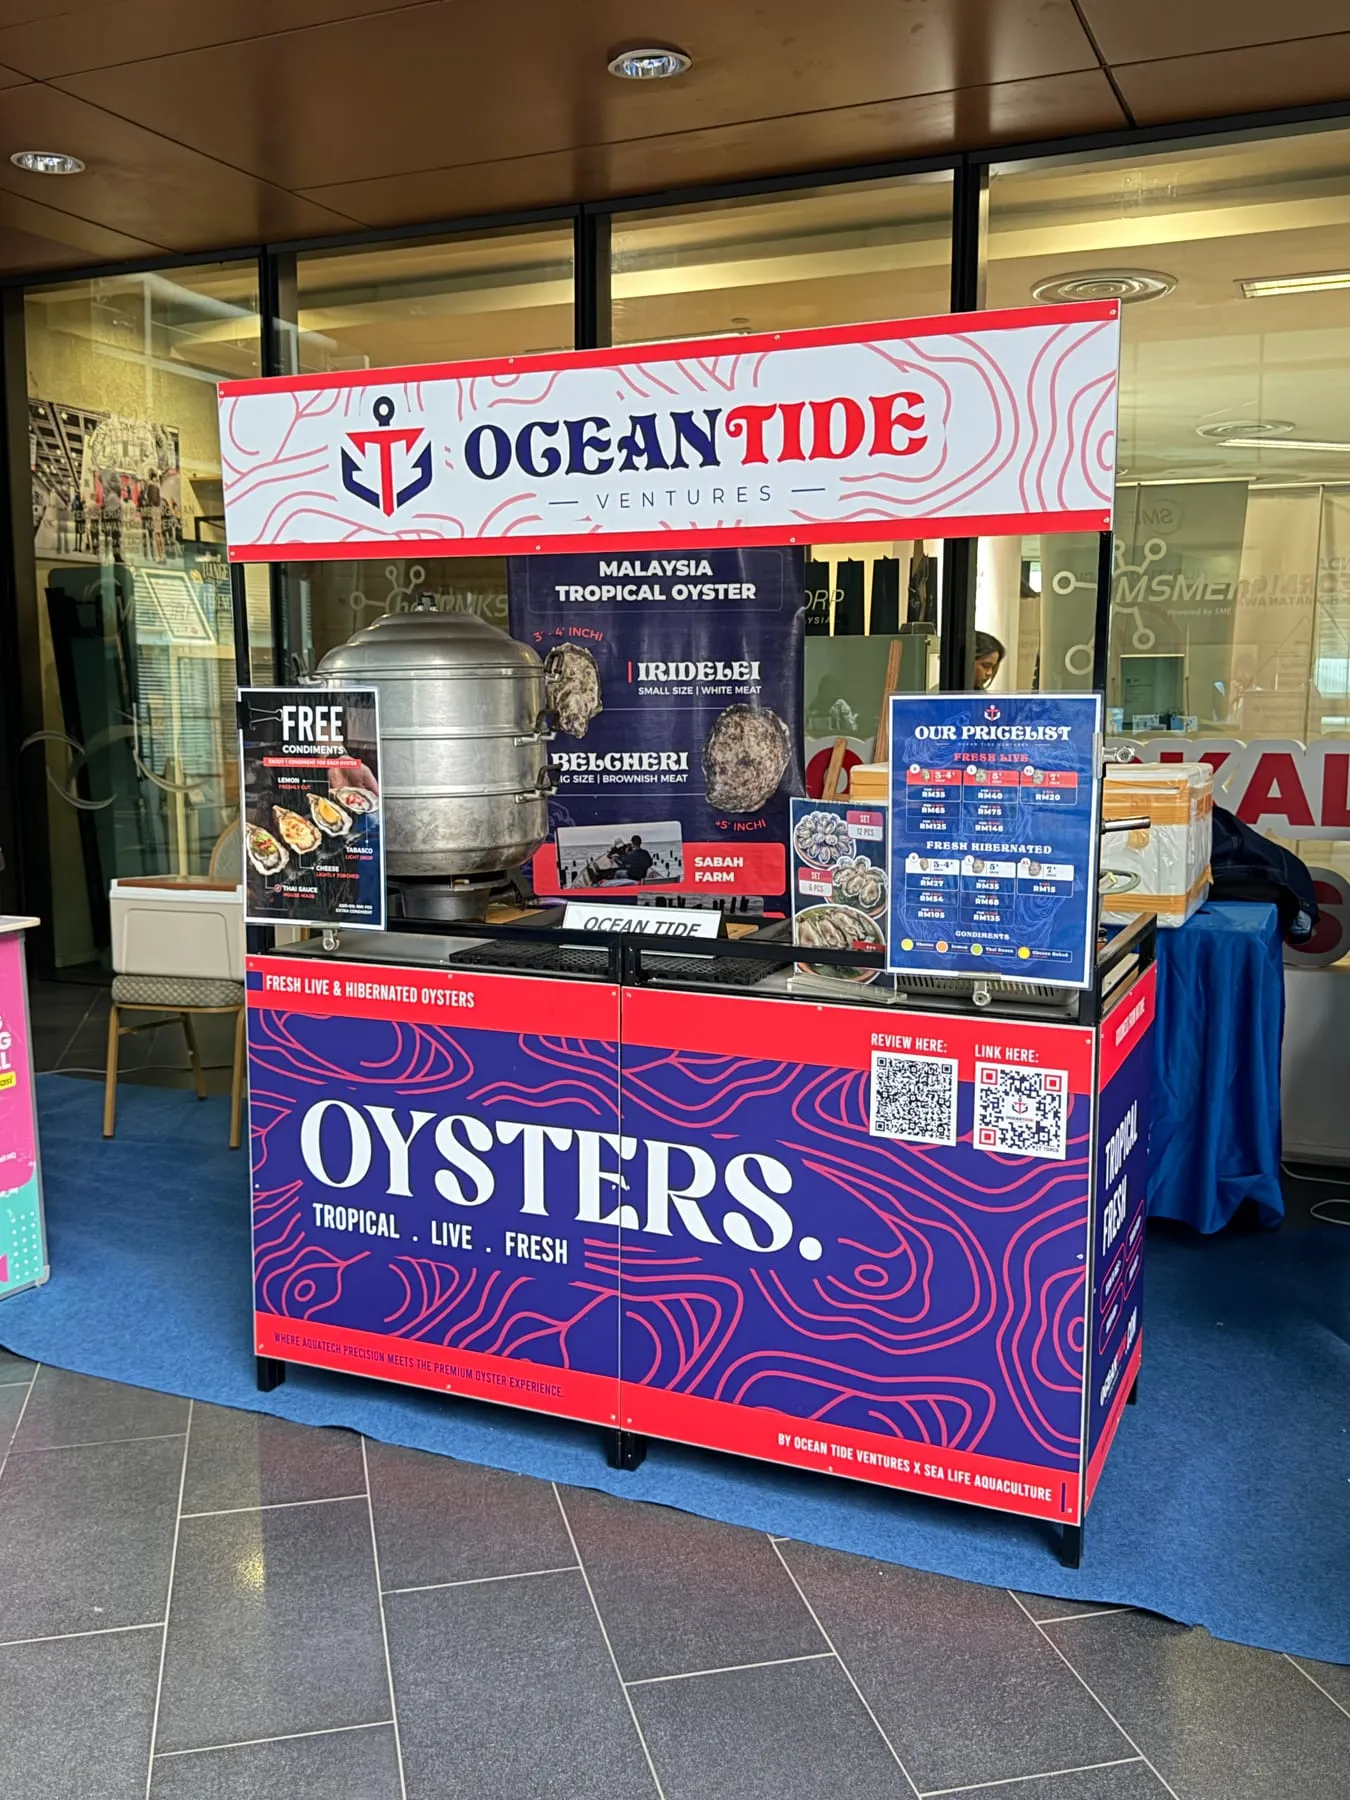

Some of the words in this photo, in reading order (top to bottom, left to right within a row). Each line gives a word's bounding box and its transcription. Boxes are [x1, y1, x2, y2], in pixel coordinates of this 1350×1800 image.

[596, 484, 773, 510] VENTURES
[599, 559, 713, 577] MALAYSIA
[555, 585, 666, 602] TROPICAL
[672, 584, 756, 600] OYSTER
[568, 627, 604, 642] INCHI
[638, 661, 761, 681] IRIDELEI
[638, 686, 671, 695] SMALL
[672, 686, 694, 695] SIZE
[701, 686, 733, 695] WHITE
[735, 685, 762, 694] MEAT
[282, 705, 344, 742] FREE
[914, 725, 957, 741] OUR
[961, 725, 1072, 741] PRICELIST
[282, 745, 345, 754] CONDIMENTS
[551, 752, 689, 771] BELCHERI
[953, 752, 996, 762] FRESH
[1000, 753, 1029, 762] LIVE
[278, 776, 300, 784] LEMON
[572, 775, 594, 784] SIZE
[602, 774, 658, 783] BROWNISH
[660, 774, 688, 783] MEAT
[977, 791, 1003, 800] RM40
[1035, 793, 1060, 801] RM20
[734, 818, 767, 831] INCHI
[860, 815, 870, 824] SET
[919, 822, 947, 831] RM125
[864, 829, 875, 838] PCS
[926, 841, 968, 851] FRESH
[971, 843, 1053, 855] HIBERNATED
[694, 856, 744, 868] SABAH
[694, 871, 735, 883] FARM
[810, 872, 821, 880] SET
[920, 879, 944, 887] RM27
[918, 910, 945, 919] RM105
[973, 913, 1000, 922] RM135
[584, 916, 649, 933] OCEAN
[955, 930, 1010, 940] CONDIMENTS
[266, 975, 301, 992] FRESH
[305, 978, 330, 996] LIVE
[333, 981, 342, 996] &
[345, 982, 418, 1003] HIBERNATED
[421, 988, 475, 1008] OYSTERS
[871, 1033, 912, 1049] REVIEW
[915, 1036, 948, 1054] HERE:
[975, 1044, 1002, 1060] LINK
[1005, 1049, 1040, 1063] HERE:
[1105, 1100, 1138, 1190] TROPICAL
[300, 1099, 823, 1262] OYSTERS.
[1103, 1174, 1128, 1256] FRESH
[313, 1202, 400, 1239] TROPICAL
[431, 1220, 473, 1250] LIVE
[505, 1231, 568, 1264] FRESH
[273, 1332, 300, 1346] WHERE
[302, 1336, 341, 1354] AQUATECH
[344, 1345, 385, 1363] PRECISION
[387, 1353, 414, 1369] MEETS
[416, 1358, 432, 1372] THE
[434, 1362, 473, 1379] PREMIUM
[475, 1370, 507, 1387] OYSTER
[509, 1376, 565, 1398] EXPERIENCE.
[778, 1432, 791, 1446] BY
[794, 1436, 828, 1455] OCEAN
[831, 1444, 854, 1461] TIDE
[856, 1448, 910, 1472] VENTURES
[913, 1461, 921, 1474] X
[924, 1463, 944, 1480] SEA
[947, 1469, 971, 1485] LIFE
[974, 1474, 1053, 1501] AQUACULTURE
